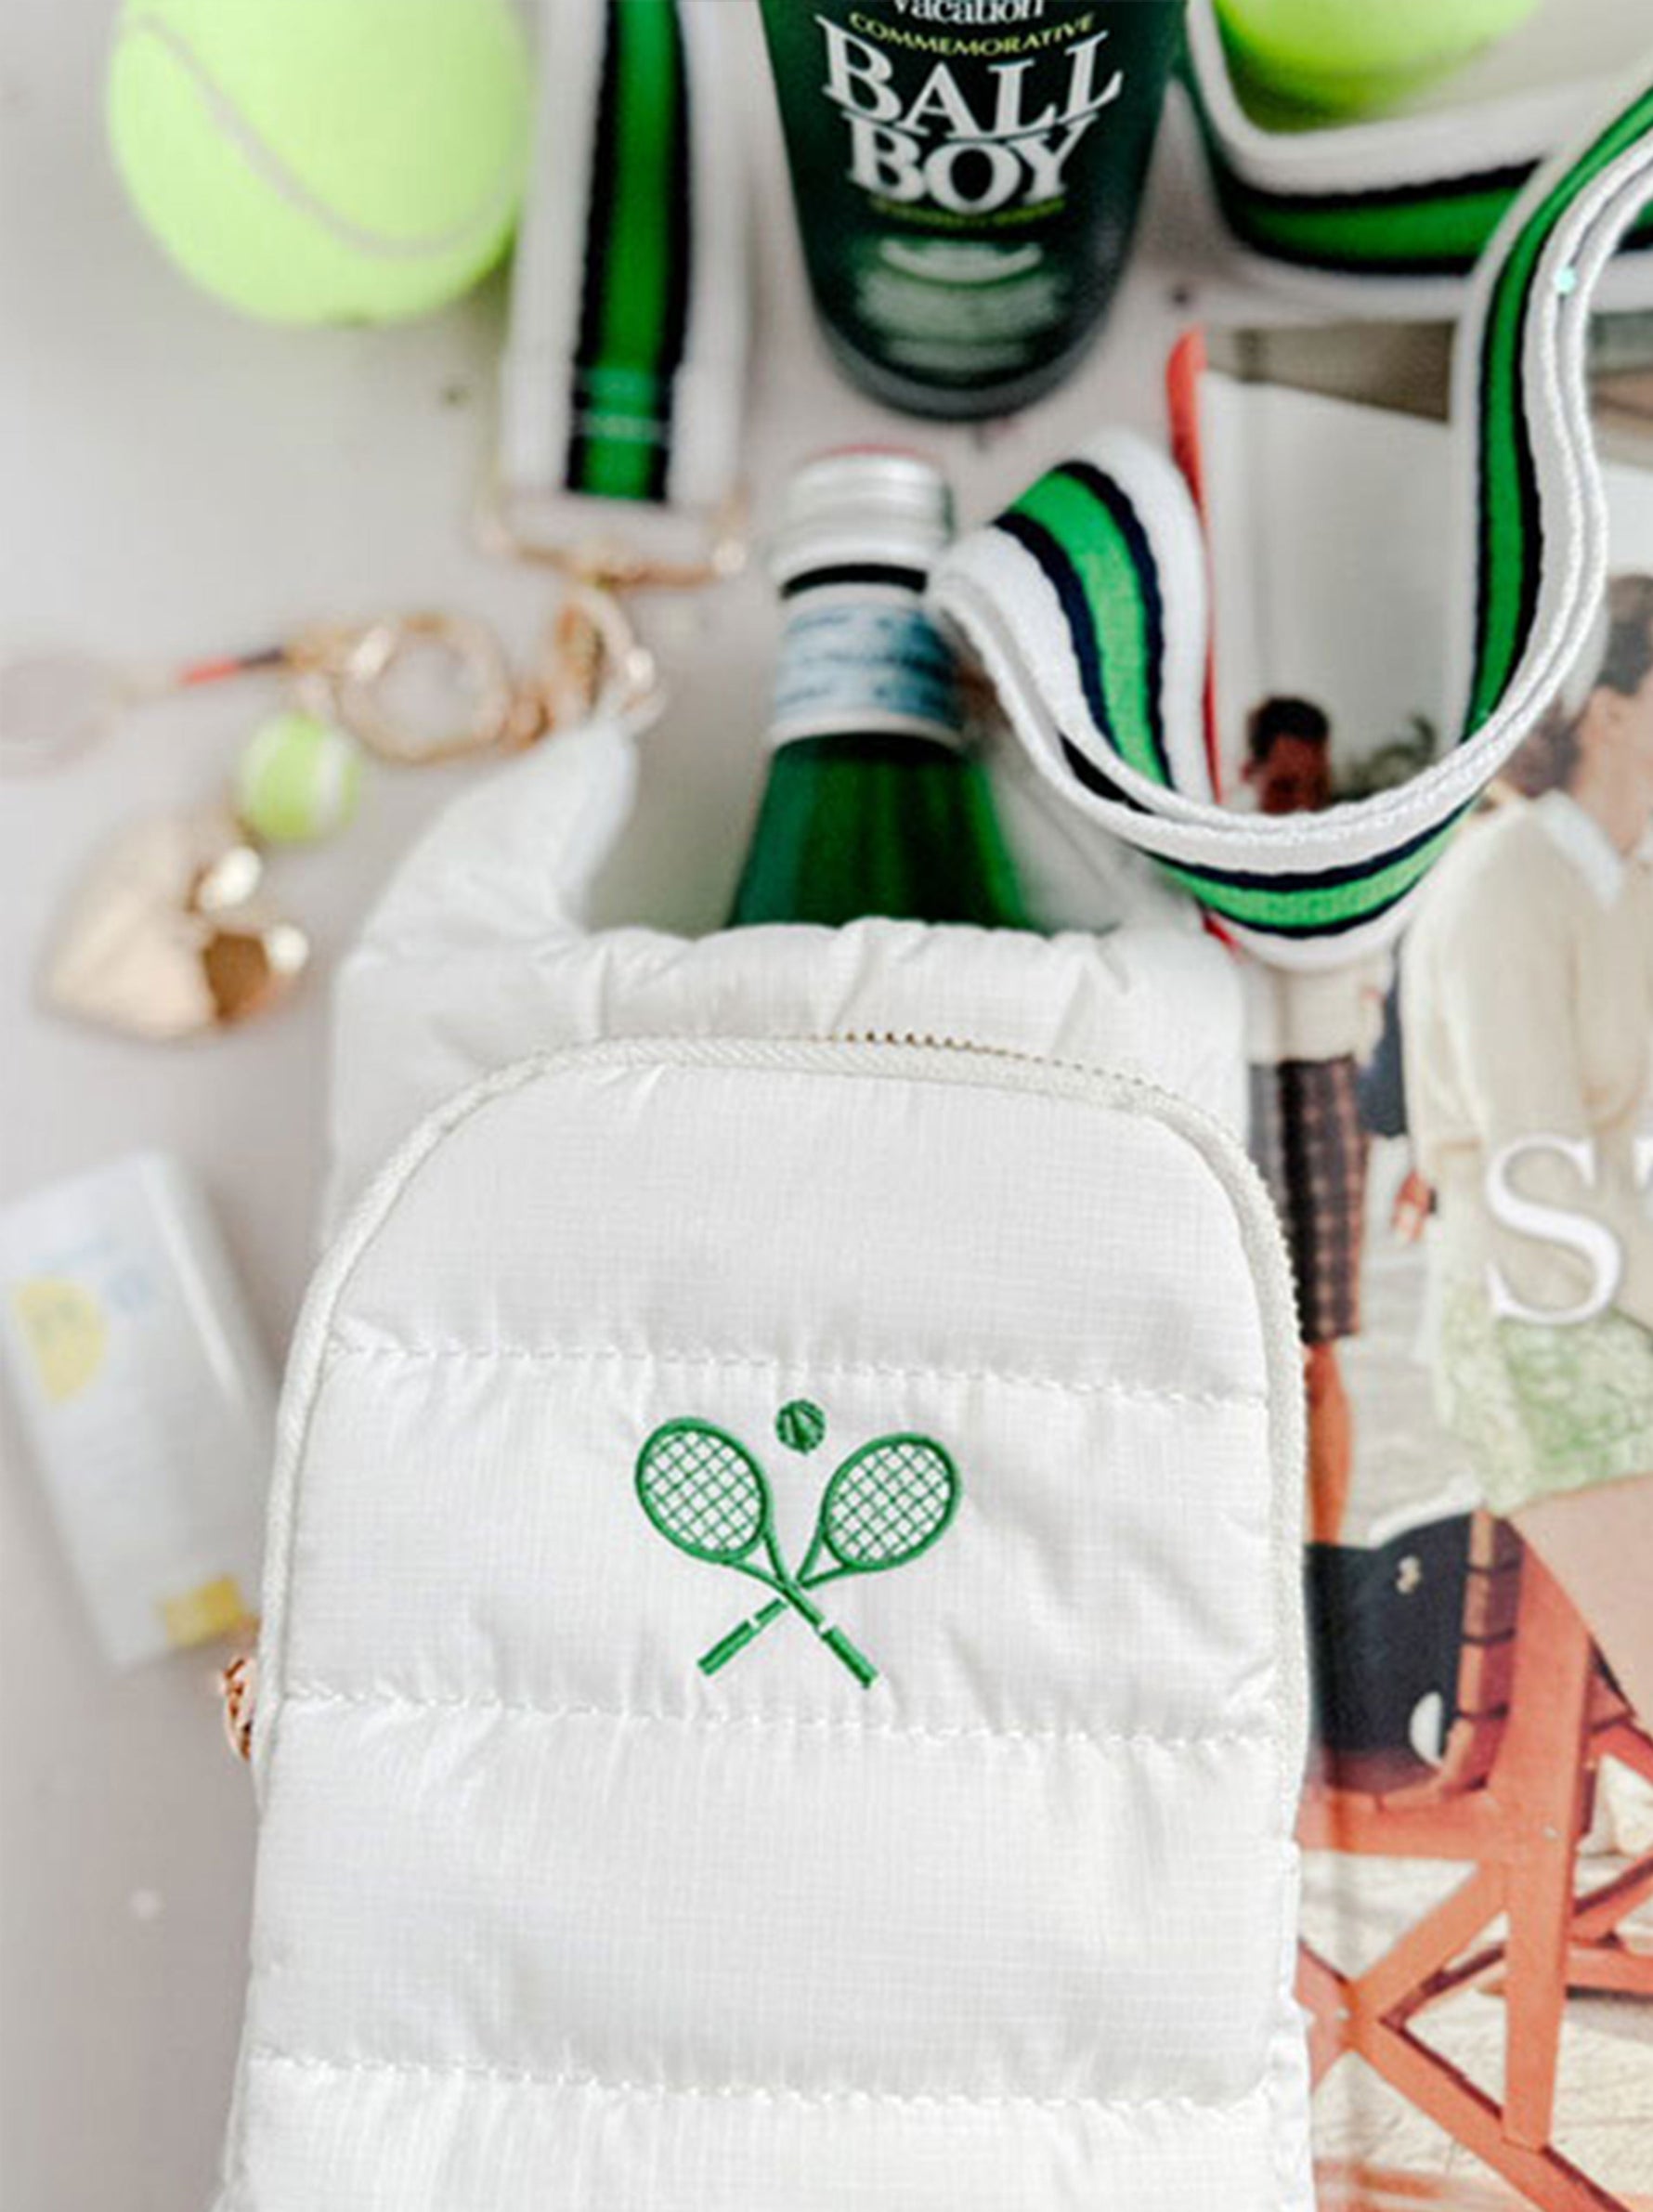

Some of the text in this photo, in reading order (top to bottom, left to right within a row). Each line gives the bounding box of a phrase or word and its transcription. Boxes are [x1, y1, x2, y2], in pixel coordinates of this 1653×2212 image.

[814, 14, 1123, 139] BALL
[849, 12, 1096, 57] COMMEMORATIVE
[840, 111, 1099, 215] BOY
[1486, 1133, 1653, 1326] S
